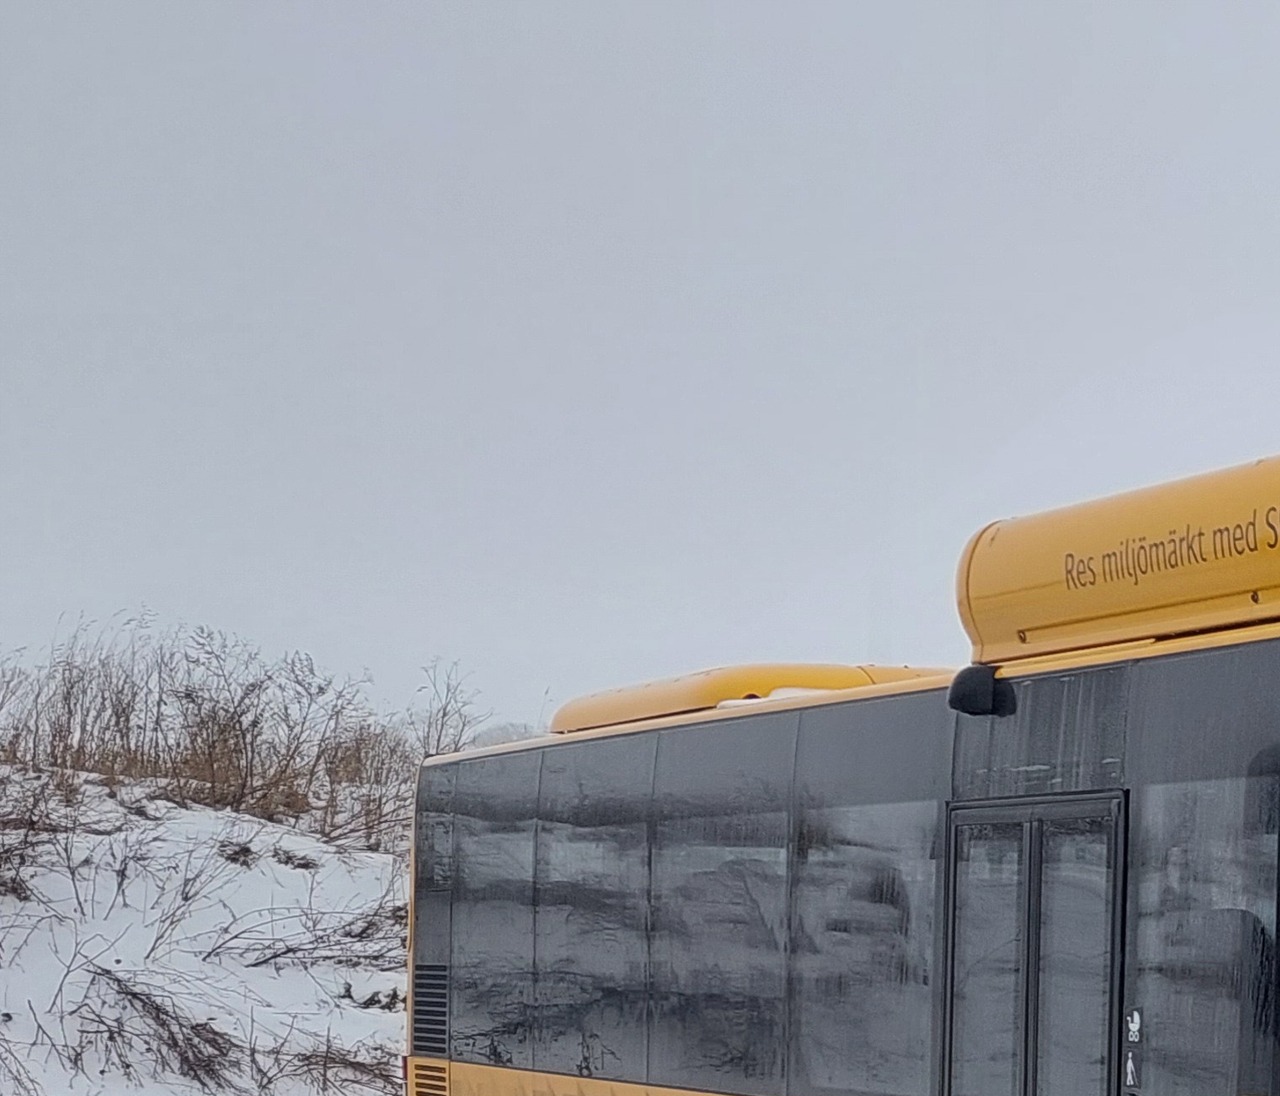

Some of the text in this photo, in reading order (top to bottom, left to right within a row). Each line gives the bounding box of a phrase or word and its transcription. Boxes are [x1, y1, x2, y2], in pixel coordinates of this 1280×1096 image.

[1064, 551, 1097, 591] Res
[1101, 523, 1208, 587] miljömärkt
[1212, 508, 1258, 561] med
